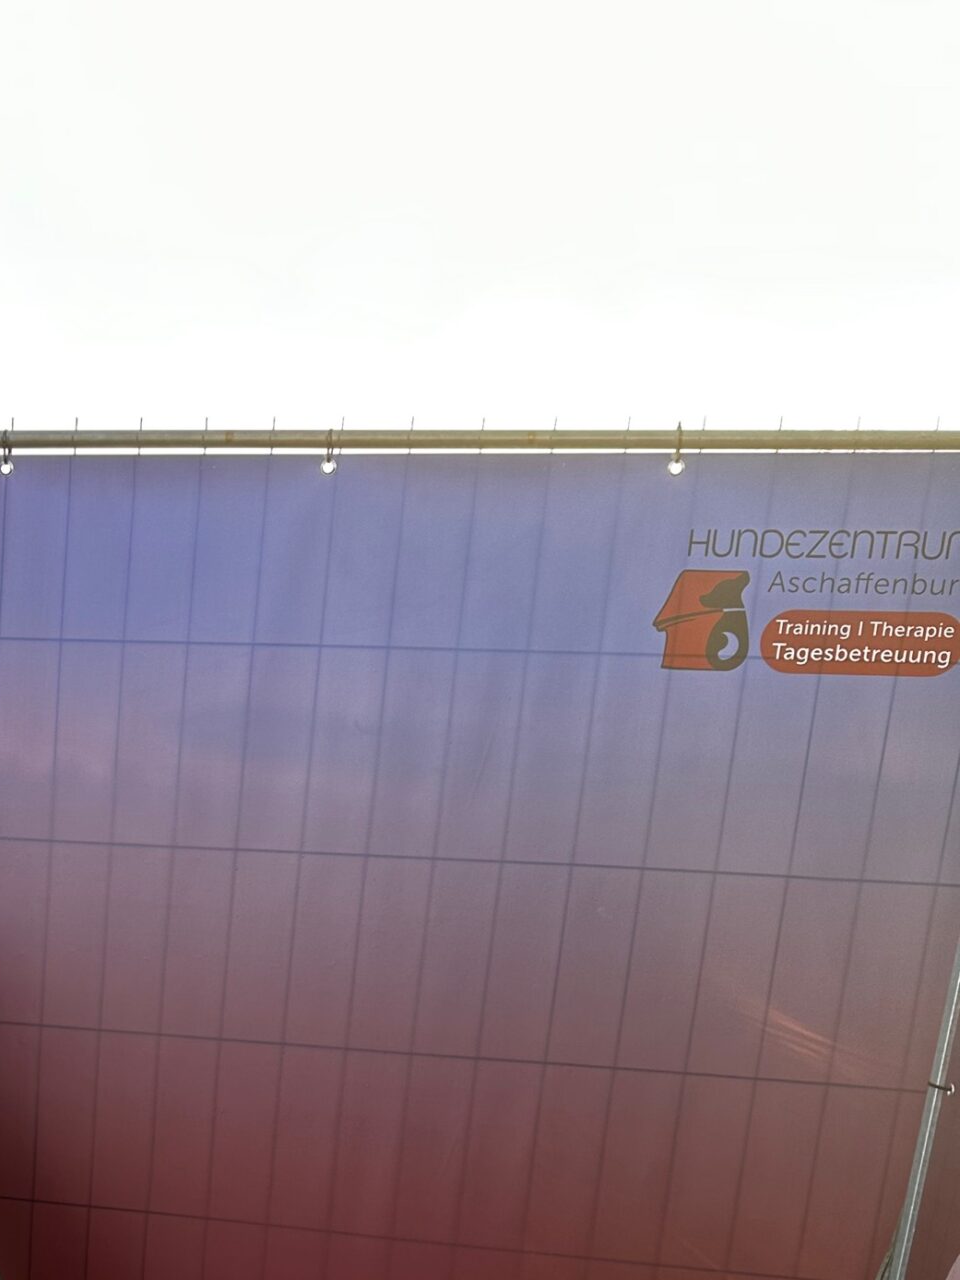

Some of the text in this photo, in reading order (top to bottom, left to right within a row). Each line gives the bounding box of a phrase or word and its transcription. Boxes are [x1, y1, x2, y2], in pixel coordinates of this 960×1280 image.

[776, 619, 851, 640] Training
[870, 620, 955, 641] Therapie
[772, 643, 952, 668] Tagesbetreuung
